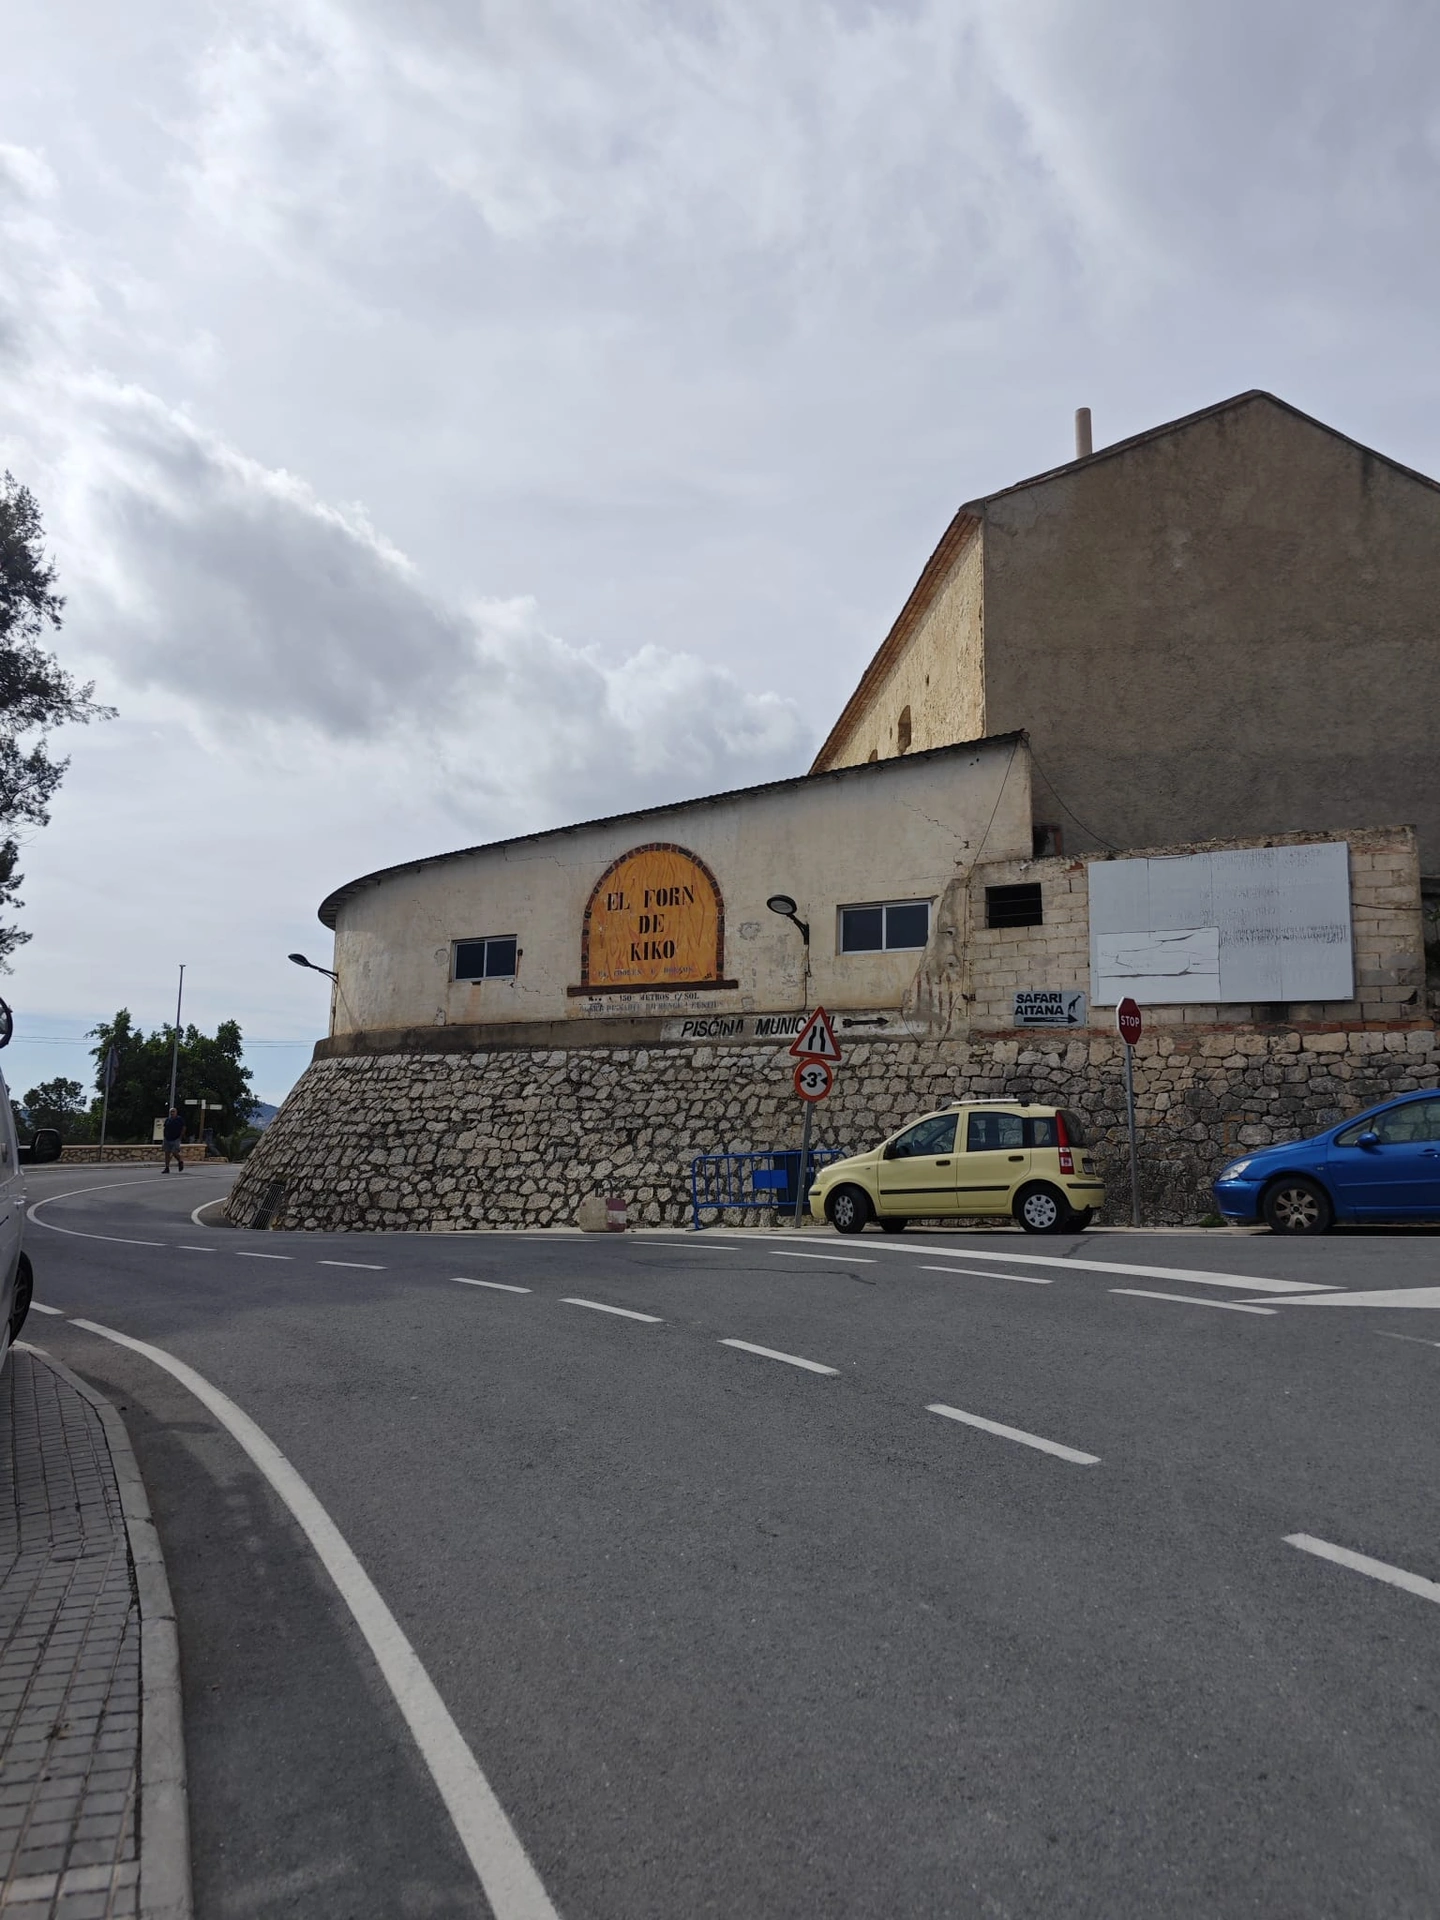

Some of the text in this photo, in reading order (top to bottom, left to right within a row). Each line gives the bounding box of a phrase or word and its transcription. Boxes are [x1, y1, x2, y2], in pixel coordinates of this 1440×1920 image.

[607, 885, 694, 911] EL FORN
[639, 914, 664, 934] DE
[631, 940, 675, 961] KIKO
[1016, 993, 1062, 1004] SAFARI
[1015, 1005, 1064, 1015] AITANA
[755, 1014, 838, 1035] MUNICL
[1121, 1015, 1140, 1028] STOP
